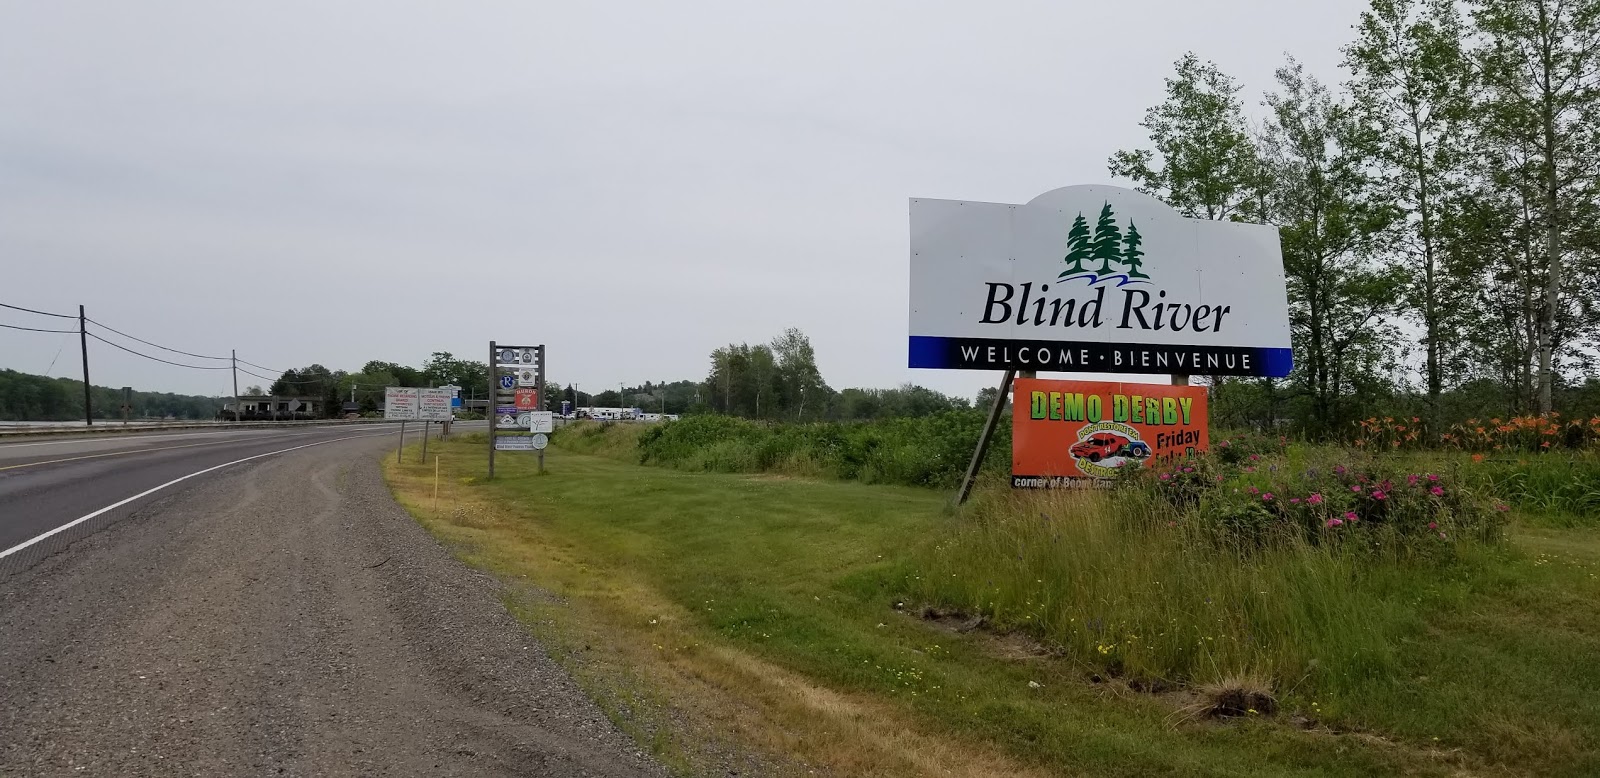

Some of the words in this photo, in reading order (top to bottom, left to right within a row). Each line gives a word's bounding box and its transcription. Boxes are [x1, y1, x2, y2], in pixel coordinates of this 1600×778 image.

[978, 282, 1106, 330] Blind
[1116, 288, 1231, 333] River
[960, 345, 1090, 365] WELCOME
[1113, 352, 1251, 370] BIENVENUE
[1030, 390, 1103, 424] DEMO
[1112, 393, 1193, 426] DERBY
[1156, 429, 1200, 450] Friday
[1078, 456, 1118, 477] DESTRO
[1014, 477, 1049, 488] corner
[1050, 477, 1061, 488] of
